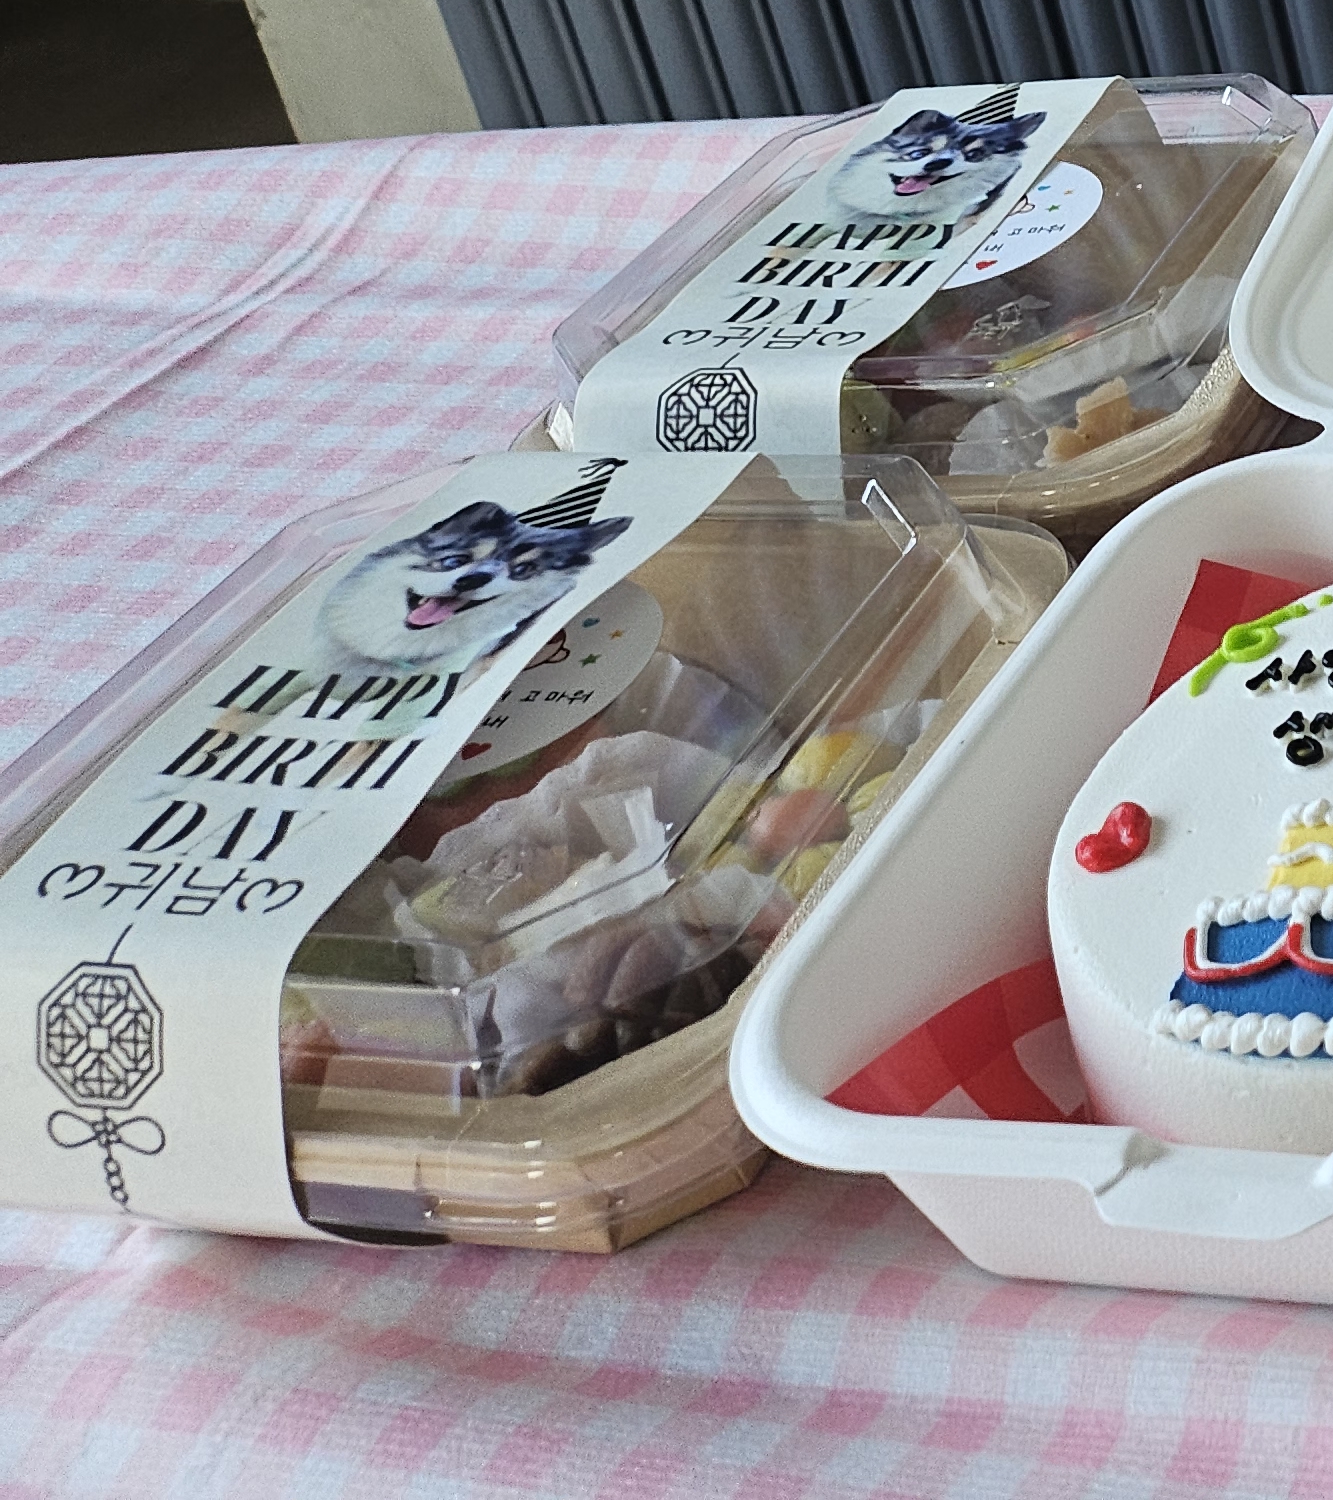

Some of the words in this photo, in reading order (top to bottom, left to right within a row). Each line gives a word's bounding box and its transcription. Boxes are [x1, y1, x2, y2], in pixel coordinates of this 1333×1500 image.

[763, 222, 959, 251] HAPPY
[1007, 223, 1067, 237] 고마워
[734, 256, 938, 288] BIRTH
[722, 296, 872, 325] DAY
[213, 664, 466, 721] HAPPY
[519, 688, 596, 706] 고마워
[157, 728, 426, 790] BIRTH
[125, 799, 329, 862] DAY
